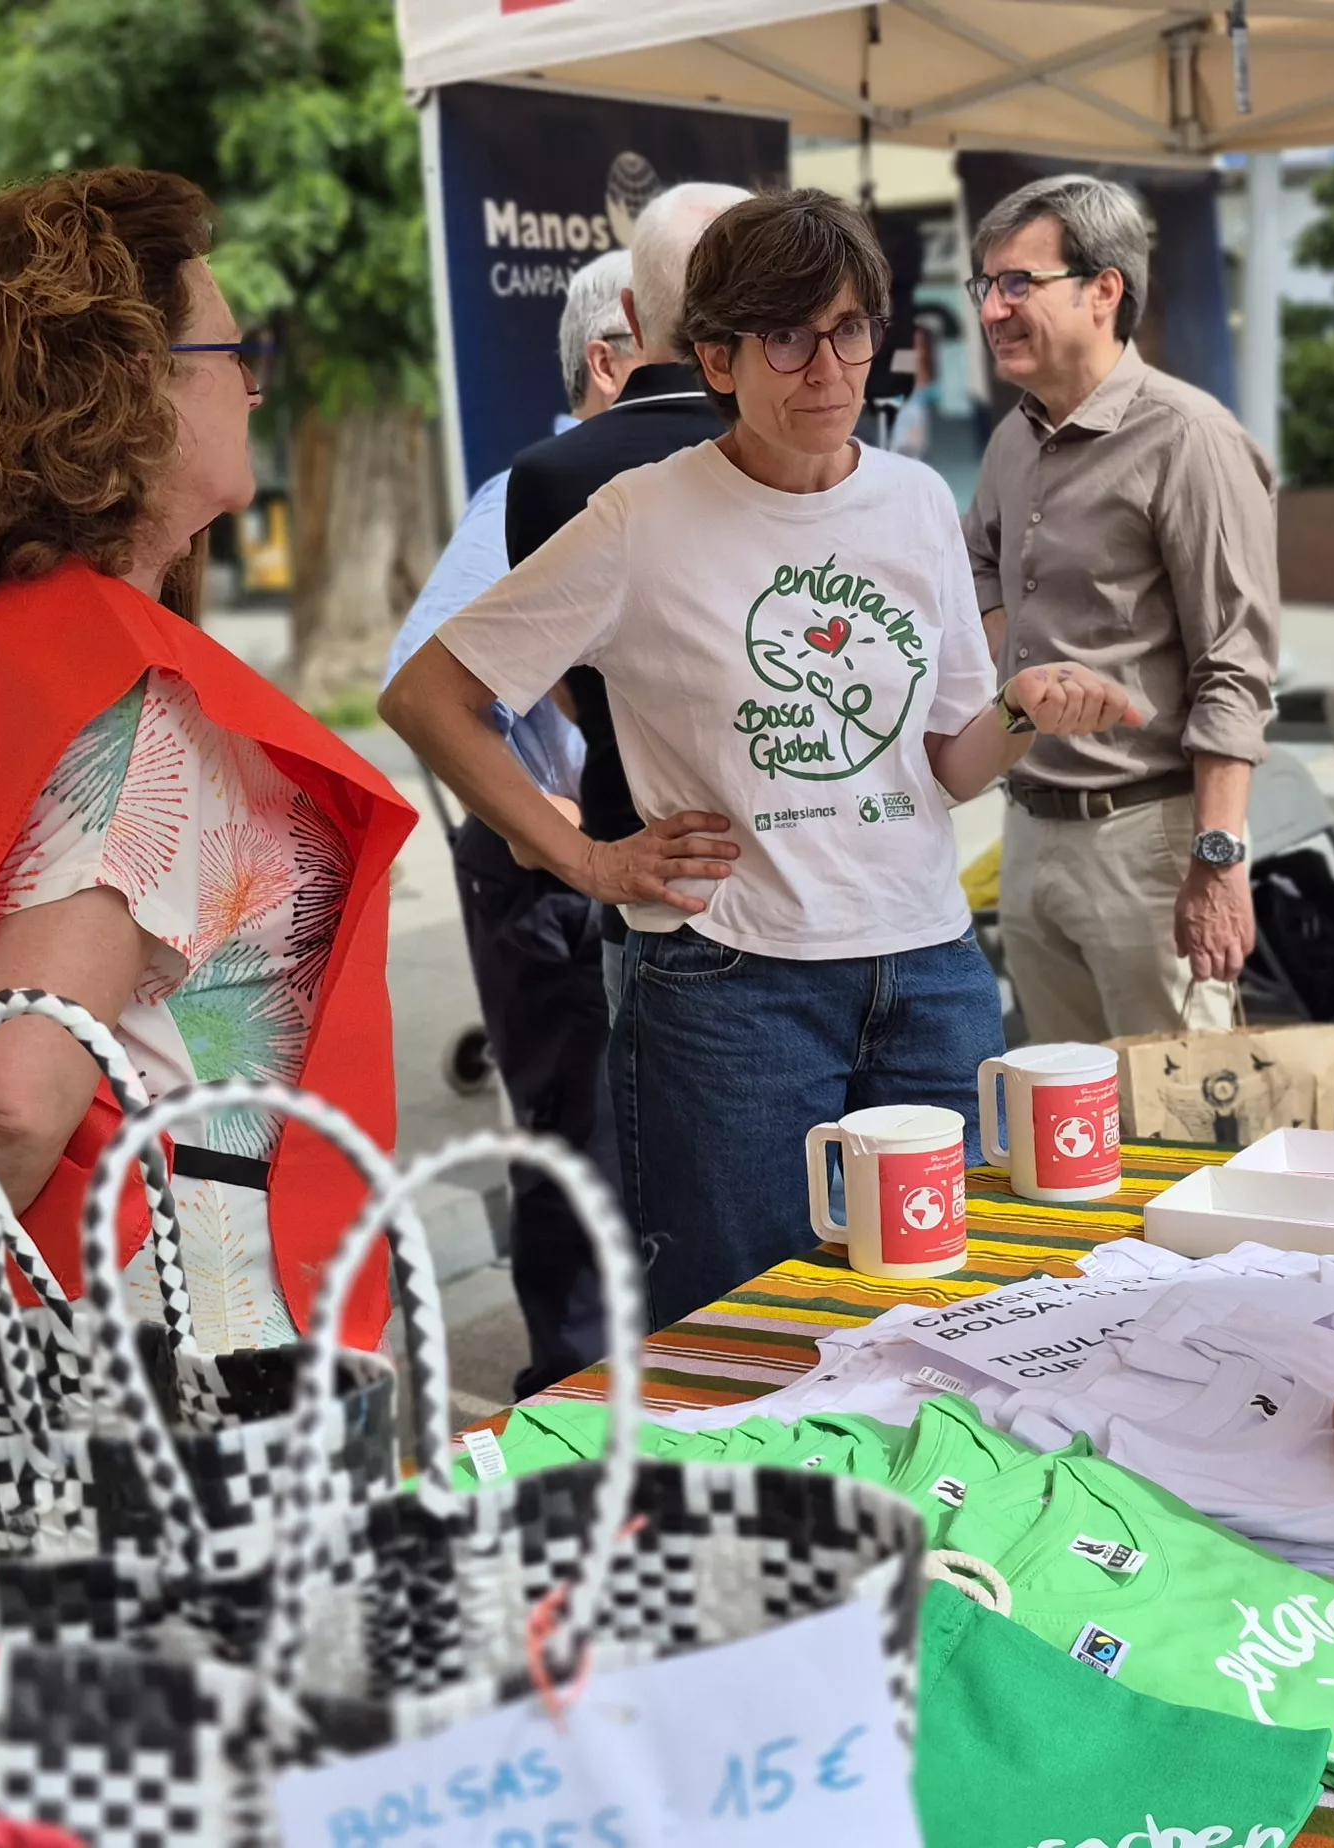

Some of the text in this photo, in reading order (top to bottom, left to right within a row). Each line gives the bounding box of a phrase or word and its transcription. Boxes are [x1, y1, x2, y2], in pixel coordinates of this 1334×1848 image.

[483, 197, 611, 251] Manos
[774, 553, 928, 679] entarachen
[734, 699, 814, 733] Bosco
[750, 729, 835, 779] Global
[773, 806, 837, 822] salesianos
[1080, 1654, 1106, 1672] COTTON
[327, 1748, 563, 1848] BOLSAS
[710, 1724, 870, 1821] 15 €
